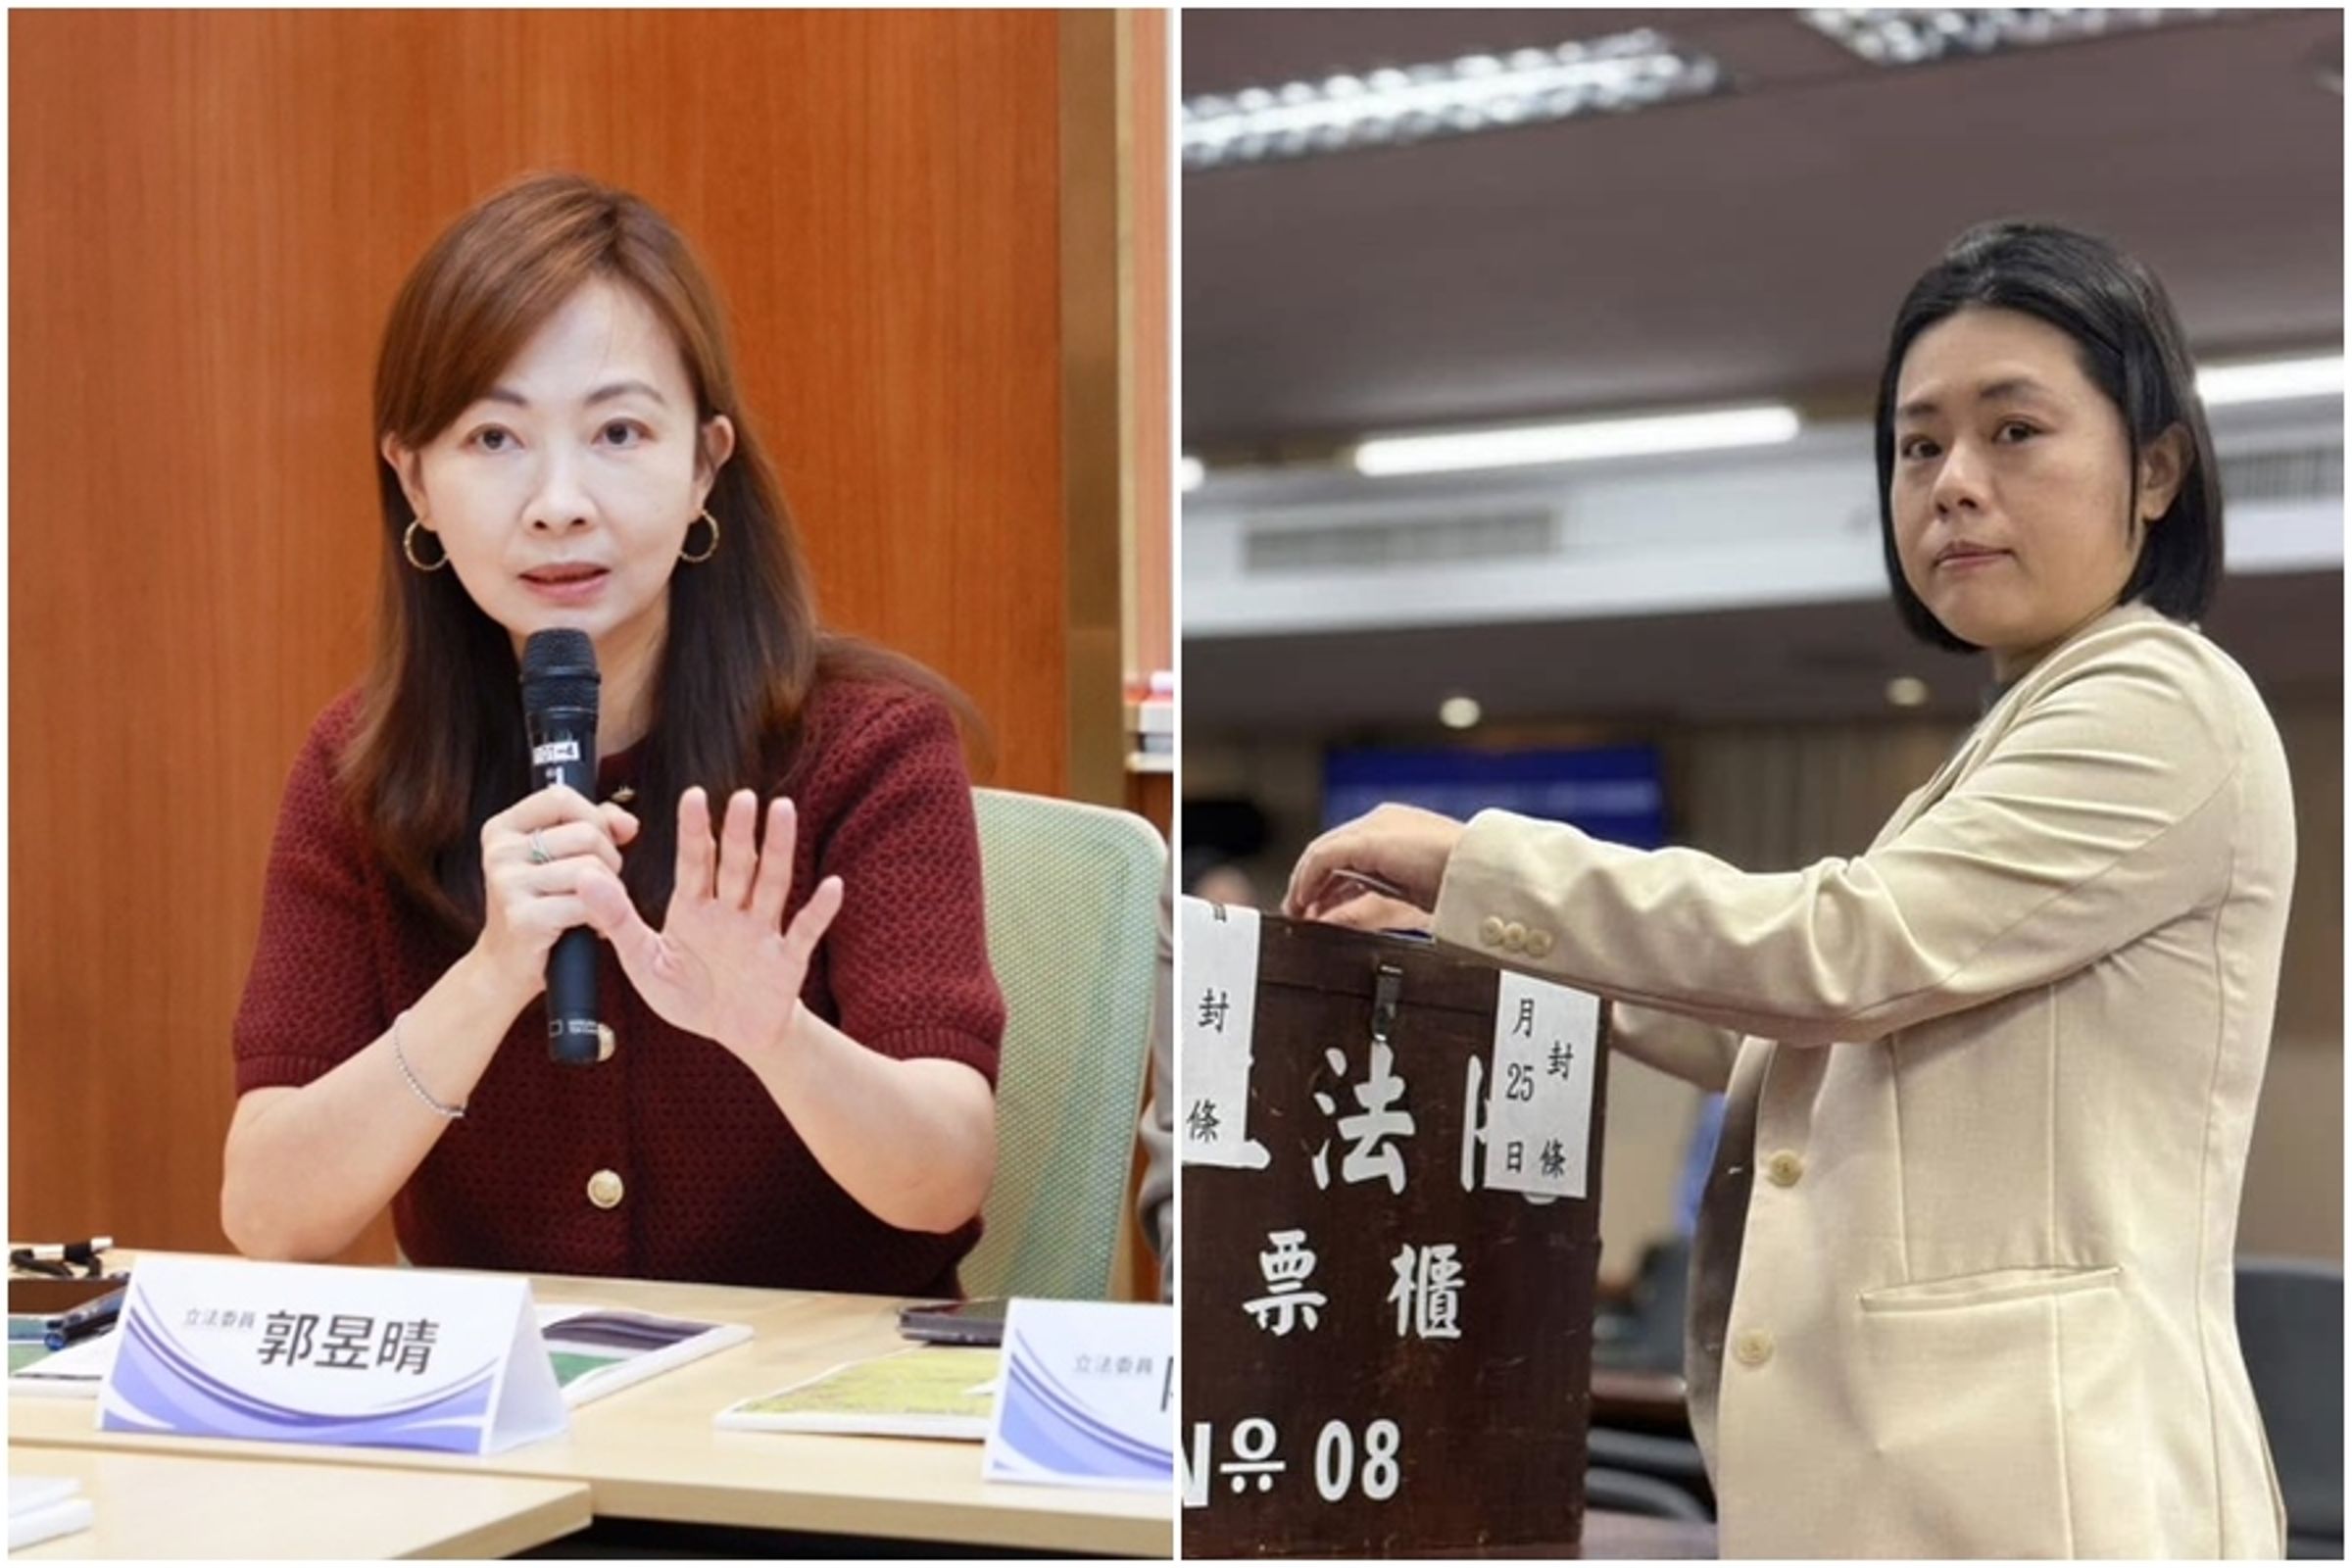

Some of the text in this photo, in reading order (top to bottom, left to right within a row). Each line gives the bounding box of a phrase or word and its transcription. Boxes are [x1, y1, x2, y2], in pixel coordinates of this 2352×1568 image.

[1540, 1040, 1574, 1179] 封條
[185, 1308, 256, 1329] 立法委員
[1243, 1229, 1465, 1340] 票櫃
[258, 1310, 440, 1375] 郭昱晴
[1314, 1419, 1399, 1501] 08
